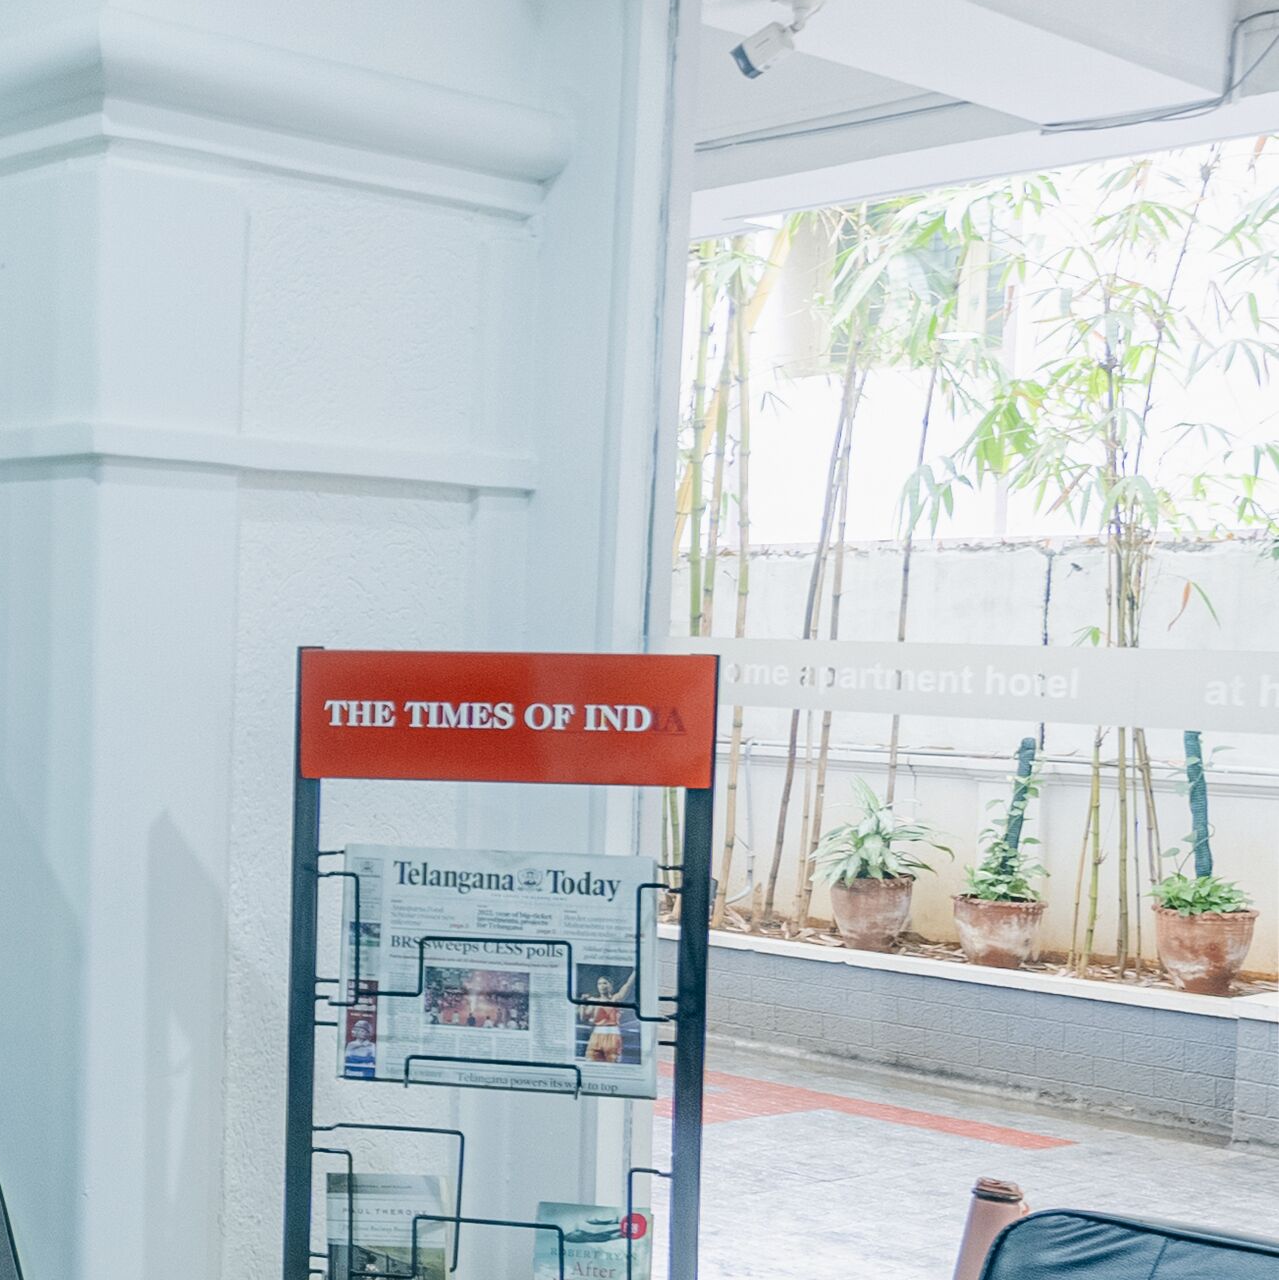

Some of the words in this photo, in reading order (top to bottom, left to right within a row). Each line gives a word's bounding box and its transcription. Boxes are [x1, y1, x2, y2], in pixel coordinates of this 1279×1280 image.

[725, 663, 789, 688] ome
[800, 664, 973, 696] apartment
[985, 665, 1080, 699] hotel
[1204, 674, 1246, 706] at
[323, 699, 397, 728] THE
[403, 701, 516, 730] TIMES
[523, 703, 576, 732] OF
[393, 860, 514, 895] Telangana
[546, 869, 621, 902] Today
[423, 940, 479, 955] sweeps
[483, 941, 522, 956] CESS
[526, 945, 563, 959] polls
[457, 1072, 508, 1087] Telangana
[510, 1075, 548, 1088] powers
[550, 1077, 563, 1088] its
[588, 1082, 599, 1090] to
[600, 1083, 619, 1094] top
[550, 1247, 602, 1259] RBERT
[571, 1261, 616, 1278] After
